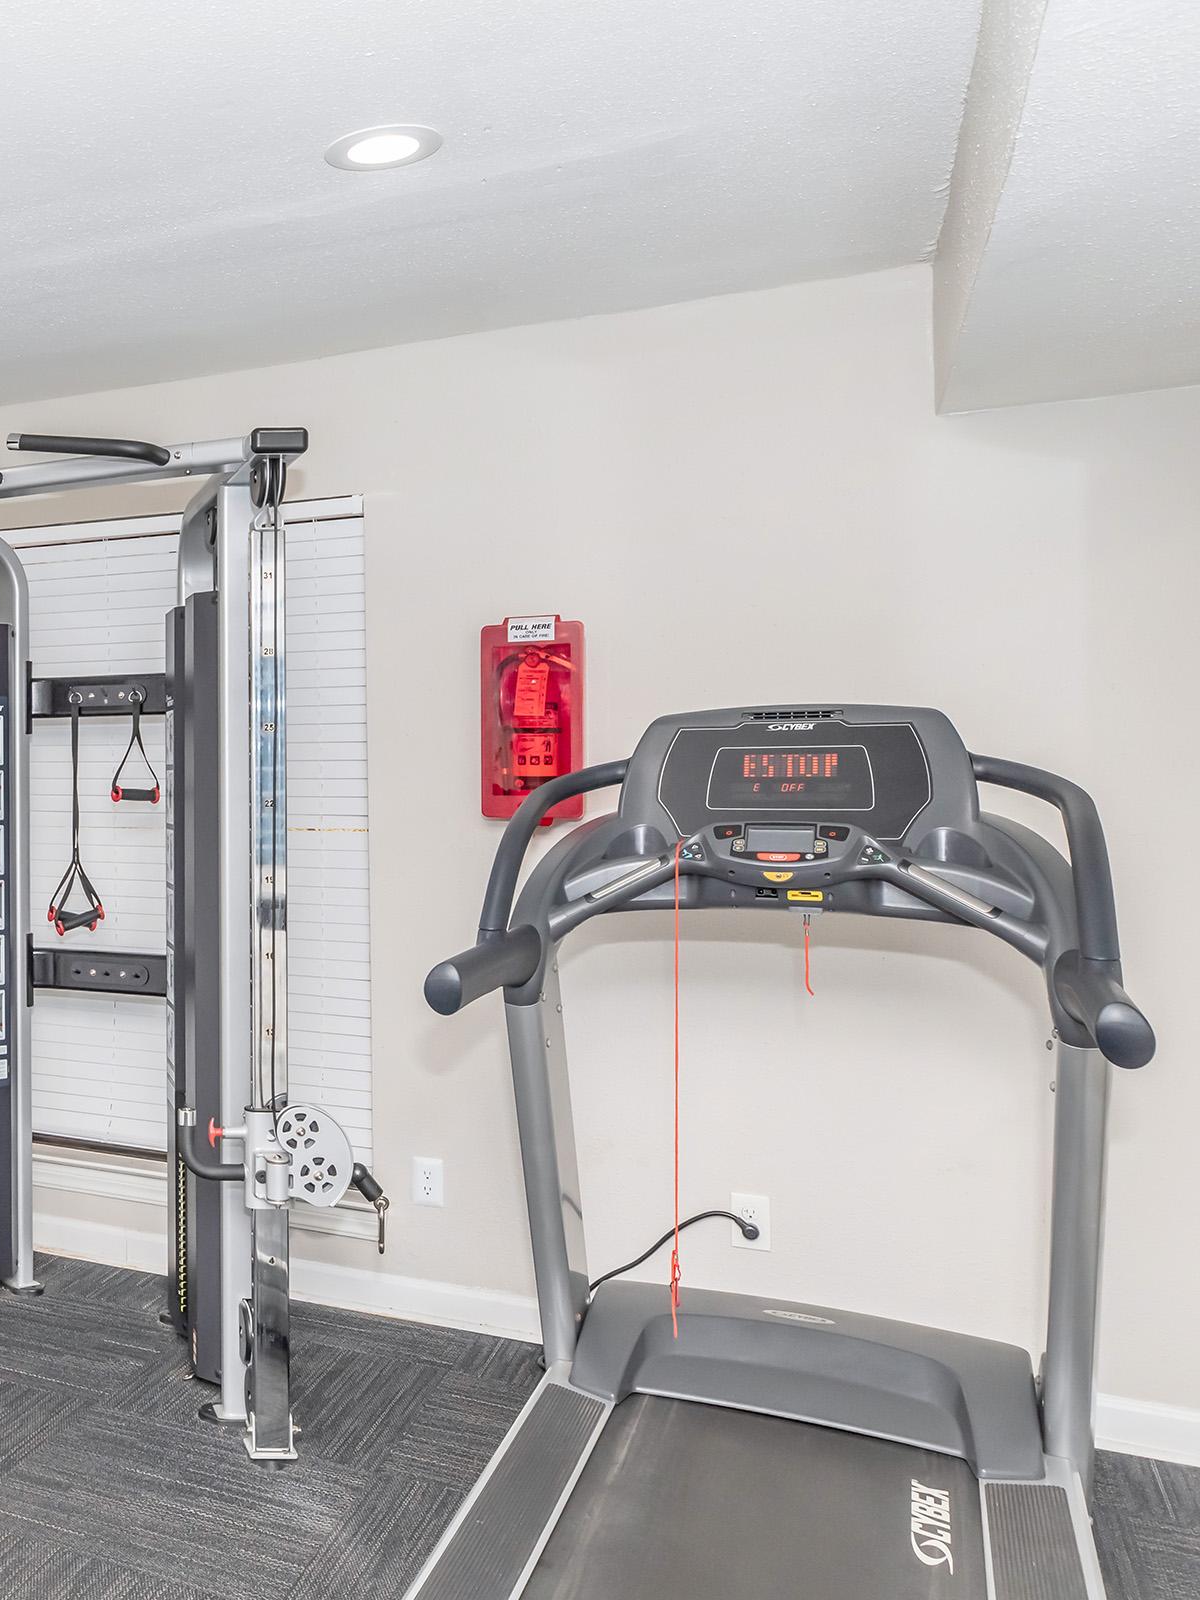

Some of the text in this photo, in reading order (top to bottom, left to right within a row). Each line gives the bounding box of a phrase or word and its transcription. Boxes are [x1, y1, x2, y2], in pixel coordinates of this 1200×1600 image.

[263, 571, 273, 580] 31
[264, 723, 275, 732] 25
[781, 723, 816, 731] CYBEX
[743, 753, 839, 778] ESTOP
[268, 1256, 275, 1265] 4
[910, 1478, 952, 1545] CYBEX
